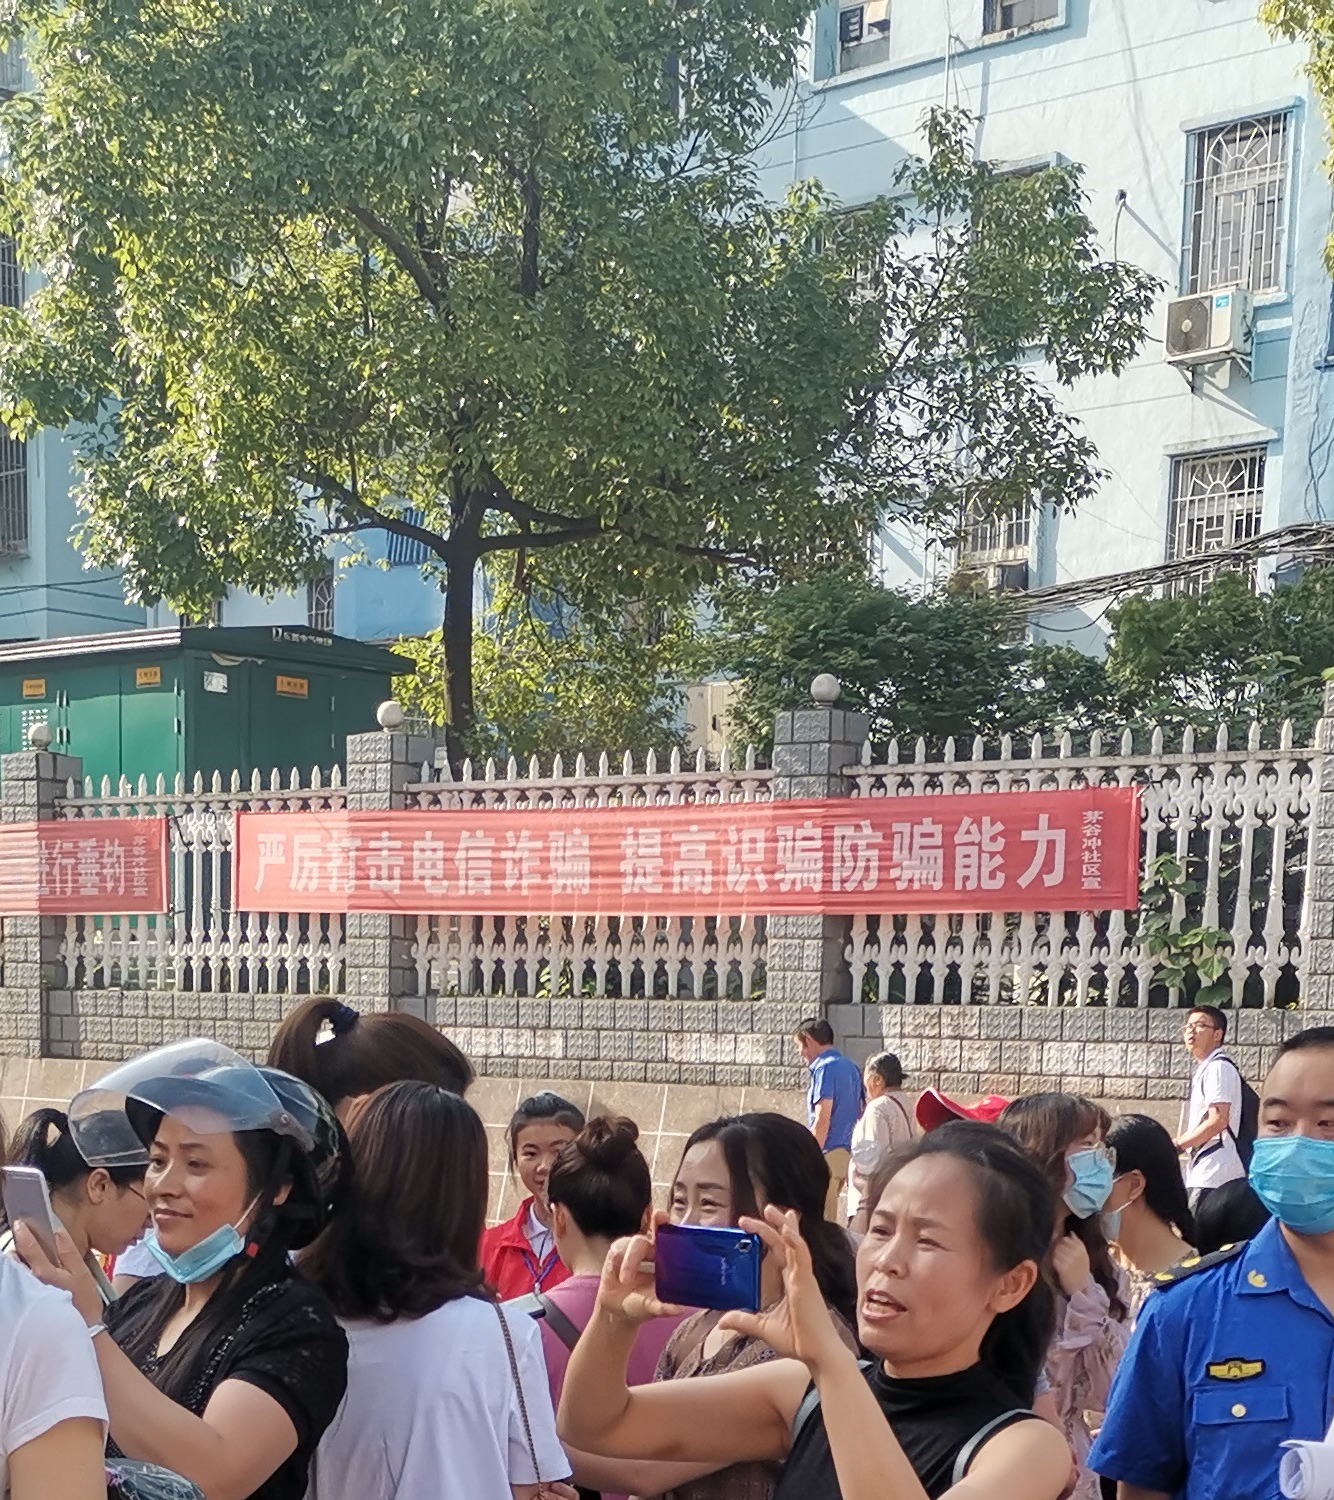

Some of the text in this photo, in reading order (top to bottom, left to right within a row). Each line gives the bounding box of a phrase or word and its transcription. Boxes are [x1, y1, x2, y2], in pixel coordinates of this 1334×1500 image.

[255, 813, 1067, 896] 严厉打击电信诈骗 提高识骗防骗能力
[1081, 810, 1104, 889] 茅谷冲社区宣
